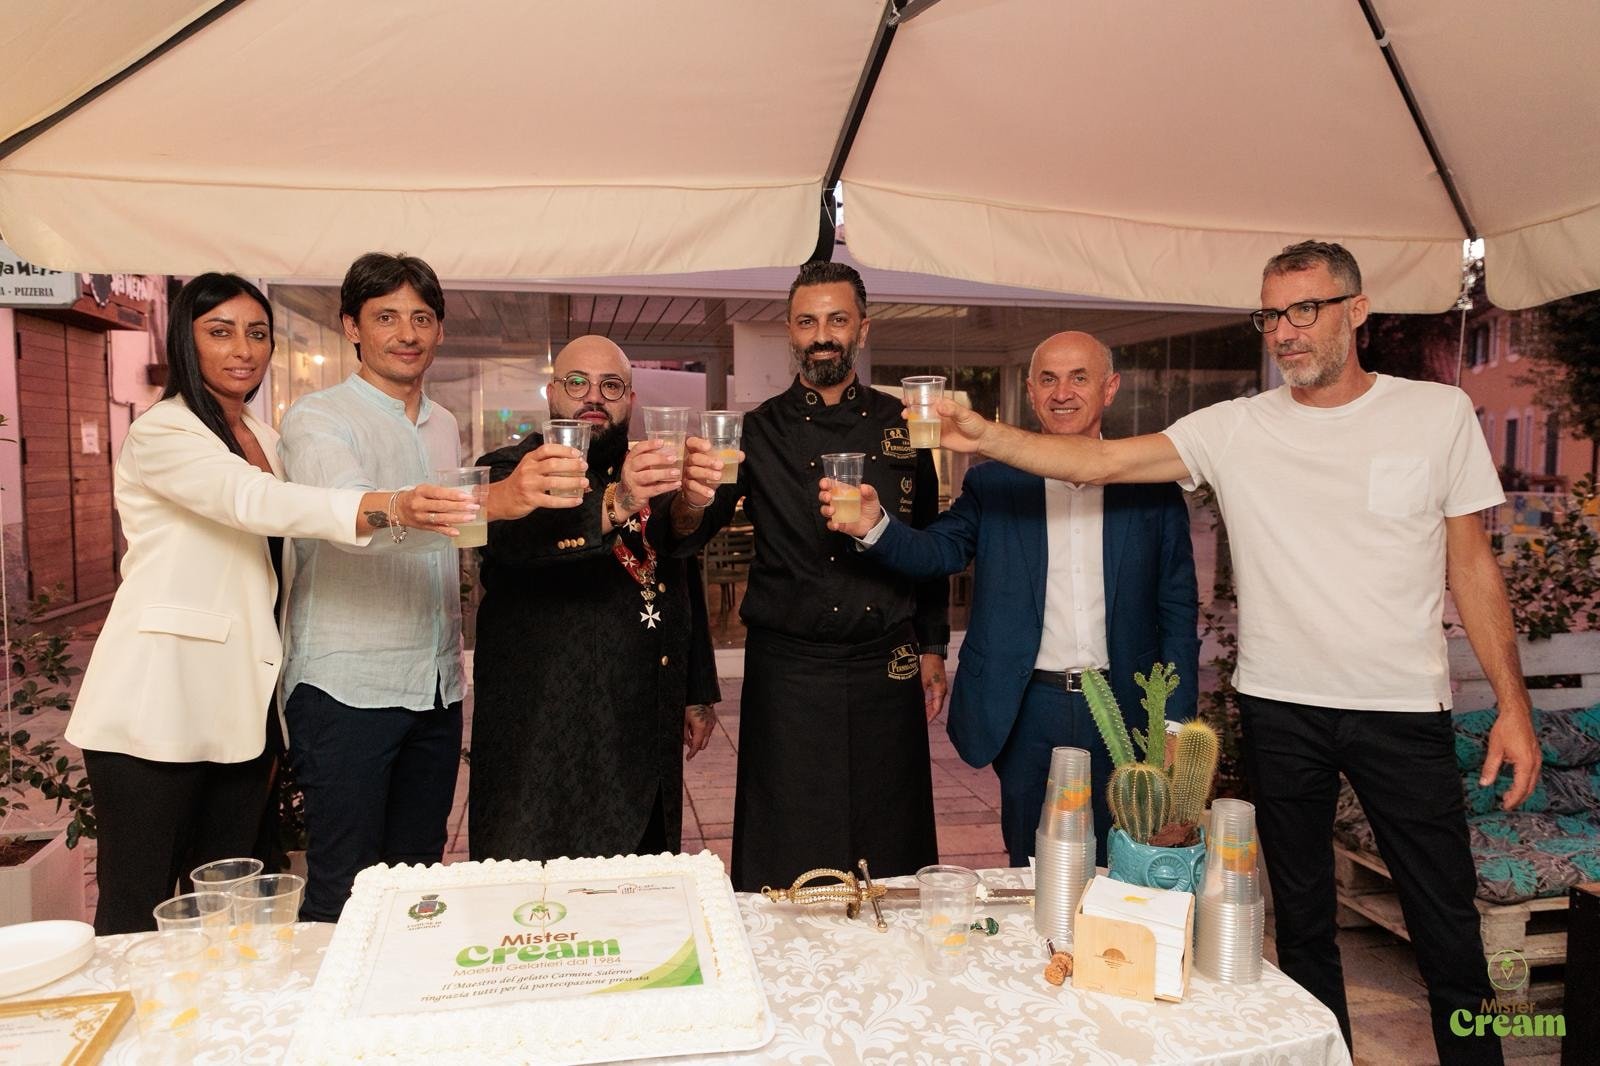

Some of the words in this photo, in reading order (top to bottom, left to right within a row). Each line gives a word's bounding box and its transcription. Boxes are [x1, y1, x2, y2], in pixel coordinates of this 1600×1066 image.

[14, 287, 54, 297] PIZZERIA
[501, 932, 578, 947] Mister
[455, 939, 621, 967] Cream
[453, 964, 503, 977] Maestri
[506, 960, 562, 971] Gelatieri
[566, 957, 588, 966] dal
[594, 956, 621, 966] 1984
[420, 992, 470, 1002] ringrazia
[472, 988, 497, 997] tutti
[499, 985, 516, 994] per
[519, 981, 529, 990] la
[531, 978, 606, 992] partecipazione
[442, 982, 453, 991] Il
[454, 979, 497, 989] Maestro
[500, 975, 517, 984] del
[518, 973, 549, 984] gelato
[551, 970, 592, 980] Carmine
[595, 968, 632, 977] Salerno
